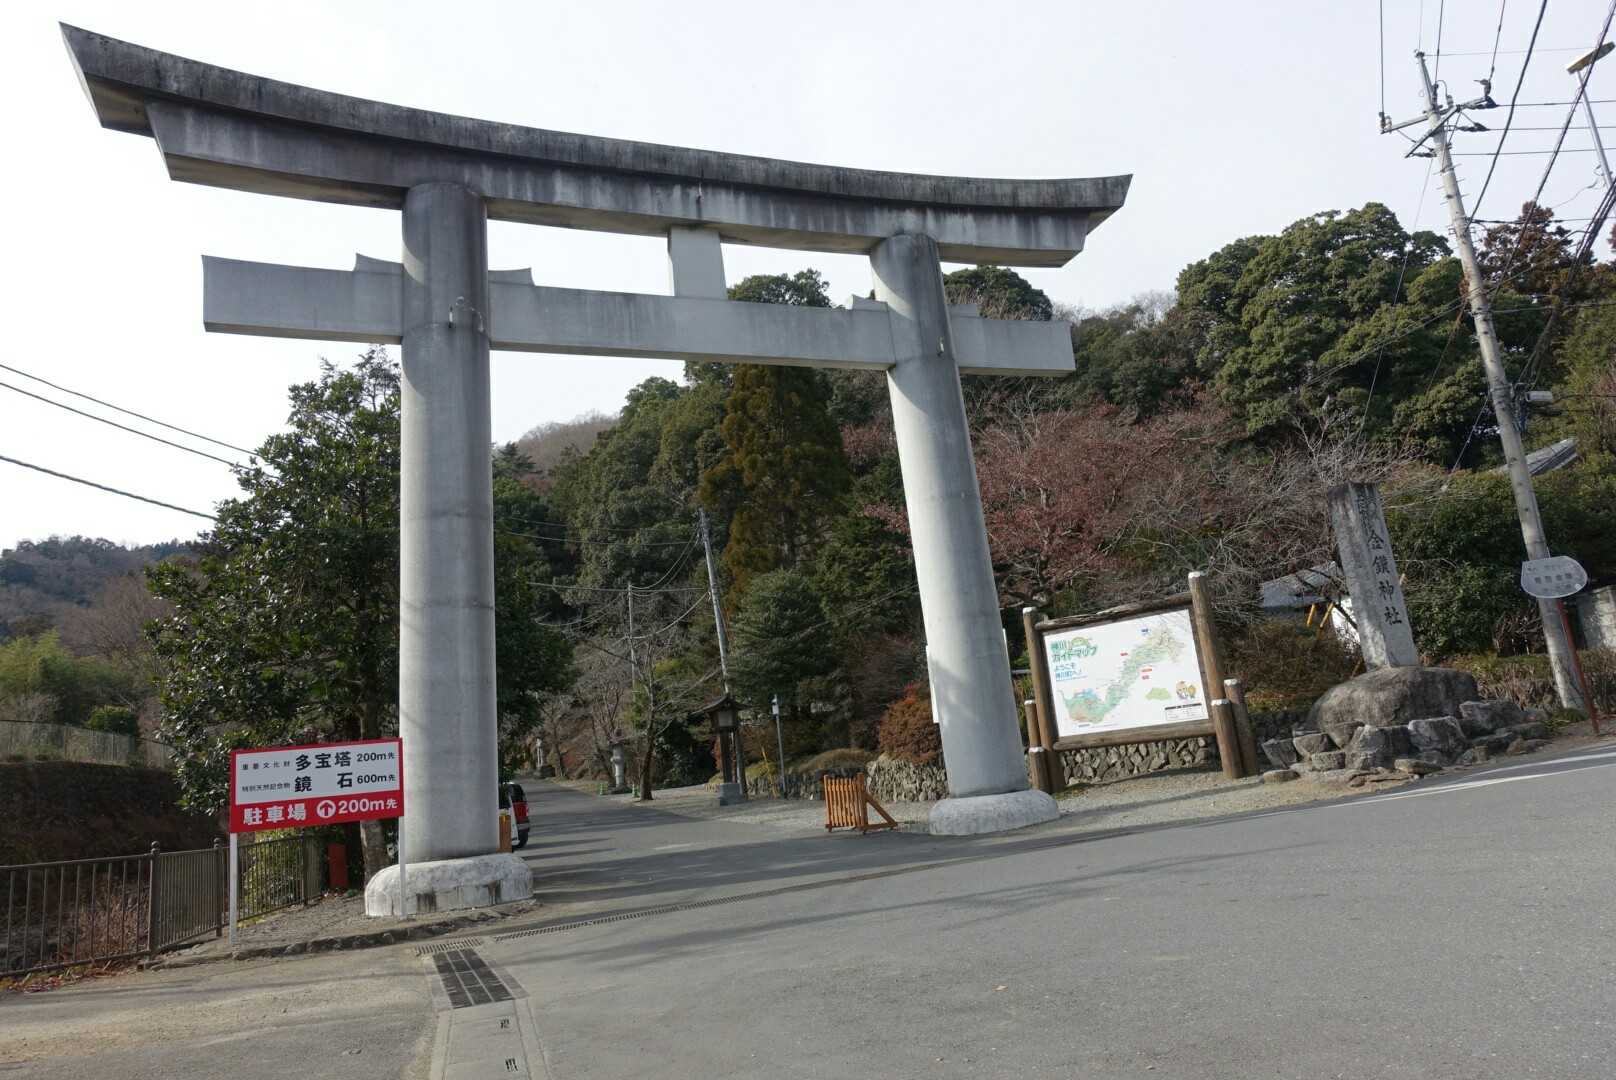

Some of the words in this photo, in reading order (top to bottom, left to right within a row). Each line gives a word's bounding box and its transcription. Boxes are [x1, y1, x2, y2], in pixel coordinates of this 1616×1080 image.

[1050, 640, 1067, 651] 神川
[1052, 646, 1098, 662] ガイドマップ
[1054, 662, 1077, 672] ようこそ
[242, 760, 291, 771] 重要文化財
[295, 751, 352, 772] 多宝塔
[356, 752, 396, 763] 200m先
[241, 783, 291, 793] 特別天然記念物
[356, 774, 396, 784] 600m先
[243, 803, 307, 826] 駐車場
[338, 798, 398, 815] 200m先
